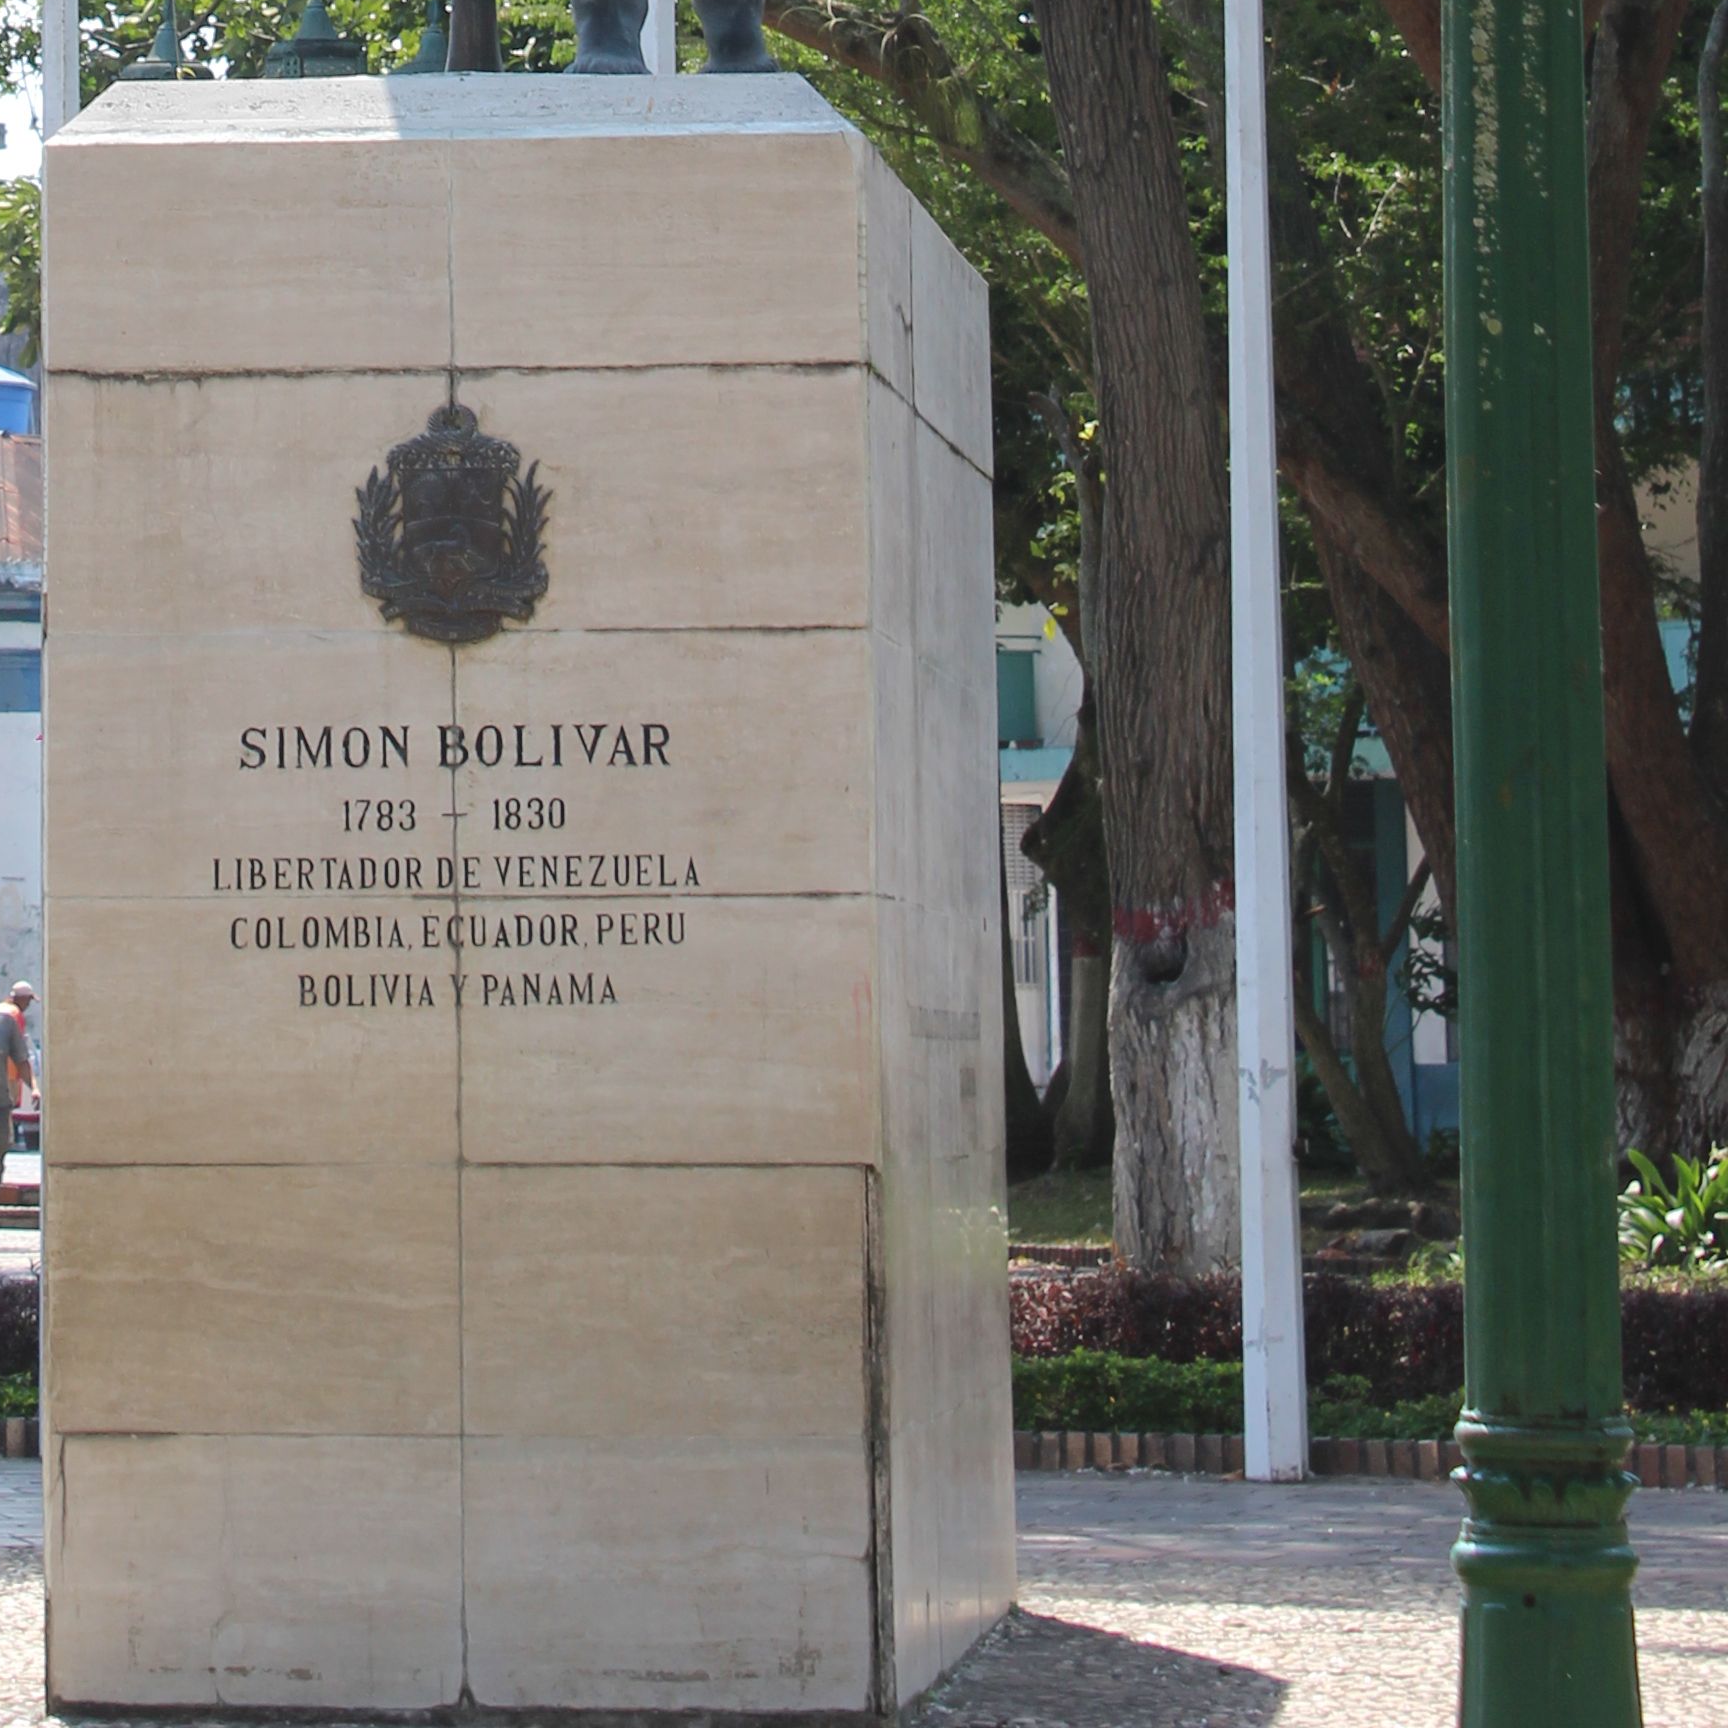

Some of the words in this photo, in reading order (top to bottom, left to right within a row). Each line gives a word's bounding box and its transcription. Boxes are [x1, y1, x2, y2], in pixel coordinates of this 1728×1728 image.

[239, 726, 410, 769] SIMON
[437, 724, 671, 768] BOLIVAR
[343, 799, 416, 832] 1783
[493, 798, 565, 830] 1830
[213, 857, 423, 890] LIBERTADOR
[437, 856, 481, 889] DE
[493, 854, 700, 888] VENEZUELA
[230, 916, 412, 951] COLOMBIA,
[422, 914, 588, 949] ECUADOR,
[596, 912, 686, 945] PERU
[298, 974, 435, 1007] BOLIVIA
[450, 973, 468, 1007] Y
[481, 972, 619, 1006] PANAMA
